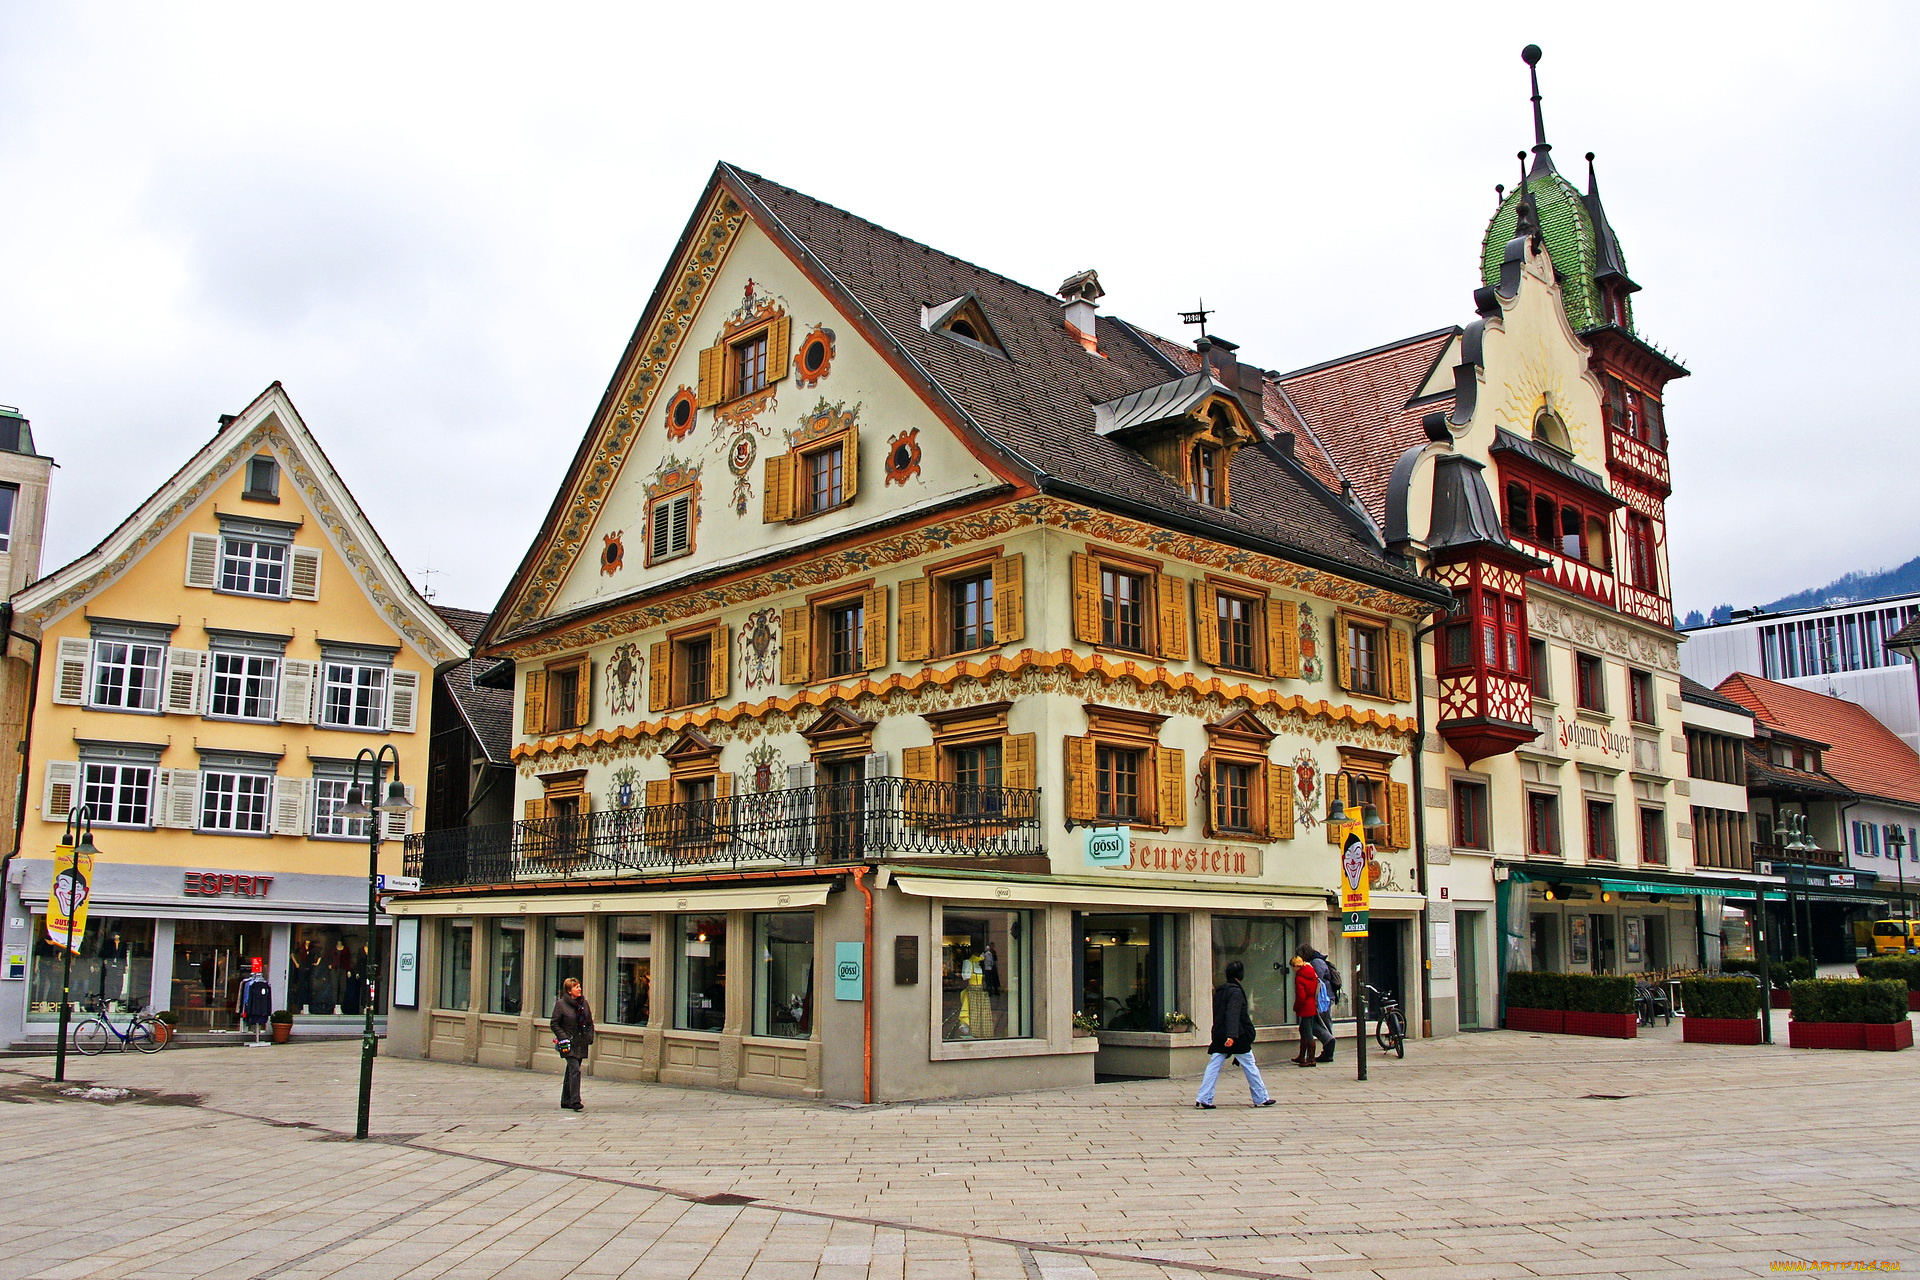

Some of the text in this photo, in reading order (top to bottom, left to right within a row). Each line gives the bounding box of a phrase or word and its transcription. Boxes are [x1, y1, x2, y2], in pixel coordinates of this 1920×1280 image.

[1558, 714, 1630, 760] Johann Luger
[1093, 838, 1119, 855] gössl
[184, 871, 275, 897] ESPRIT
[376, 875, 383, 887] P
[1442, 888, 1447, 896] 9
[1344, 923, 1366, 932] MOHREN
[840, 965, 857, 978] gössl
